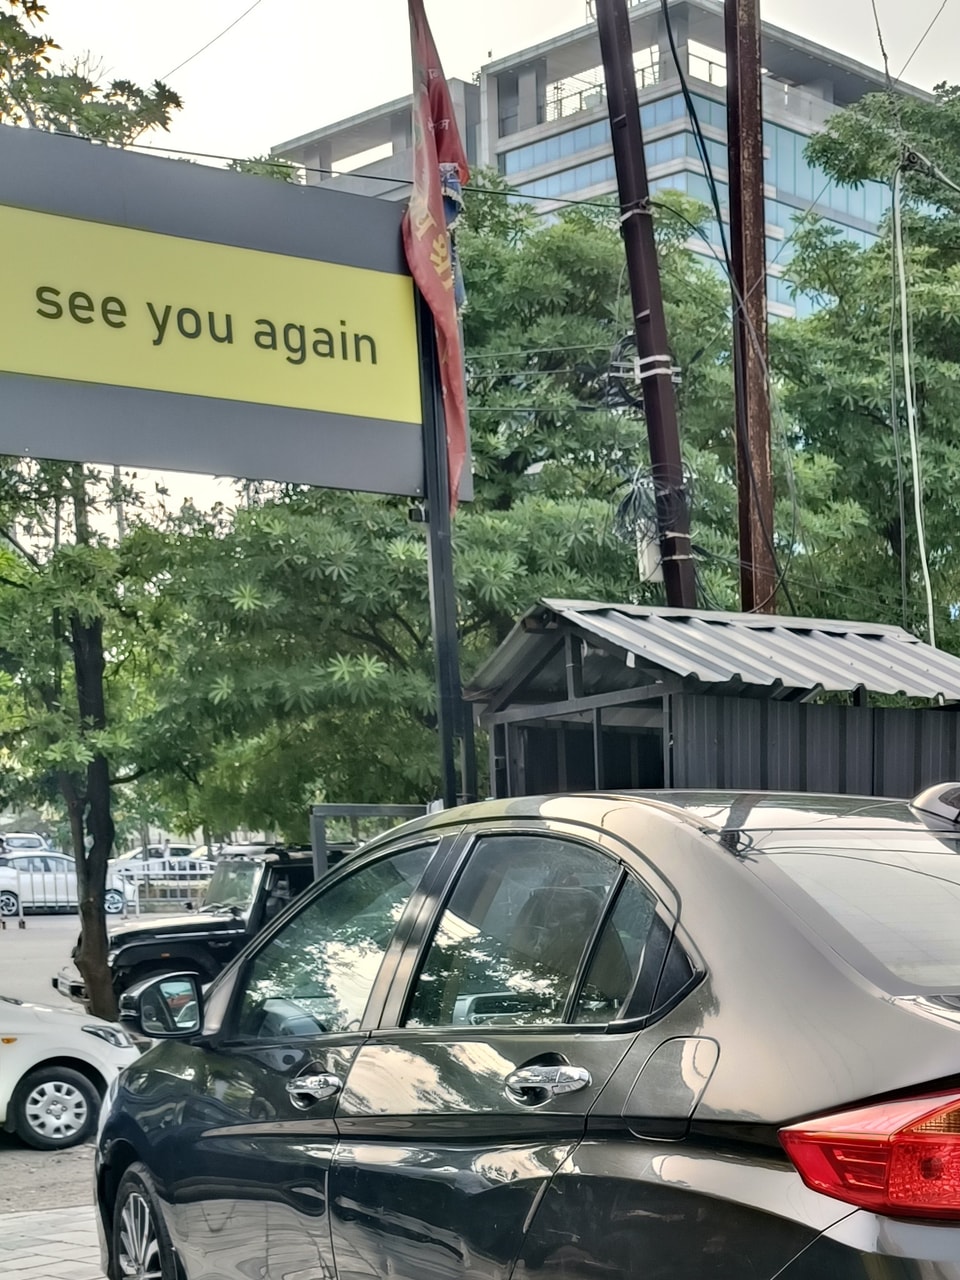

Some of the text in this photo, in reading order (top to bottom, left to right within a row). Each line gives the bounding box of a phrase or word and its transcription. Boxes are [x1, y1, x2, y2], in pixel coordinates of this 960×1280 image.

[35, 285, 378, 365] see you again
